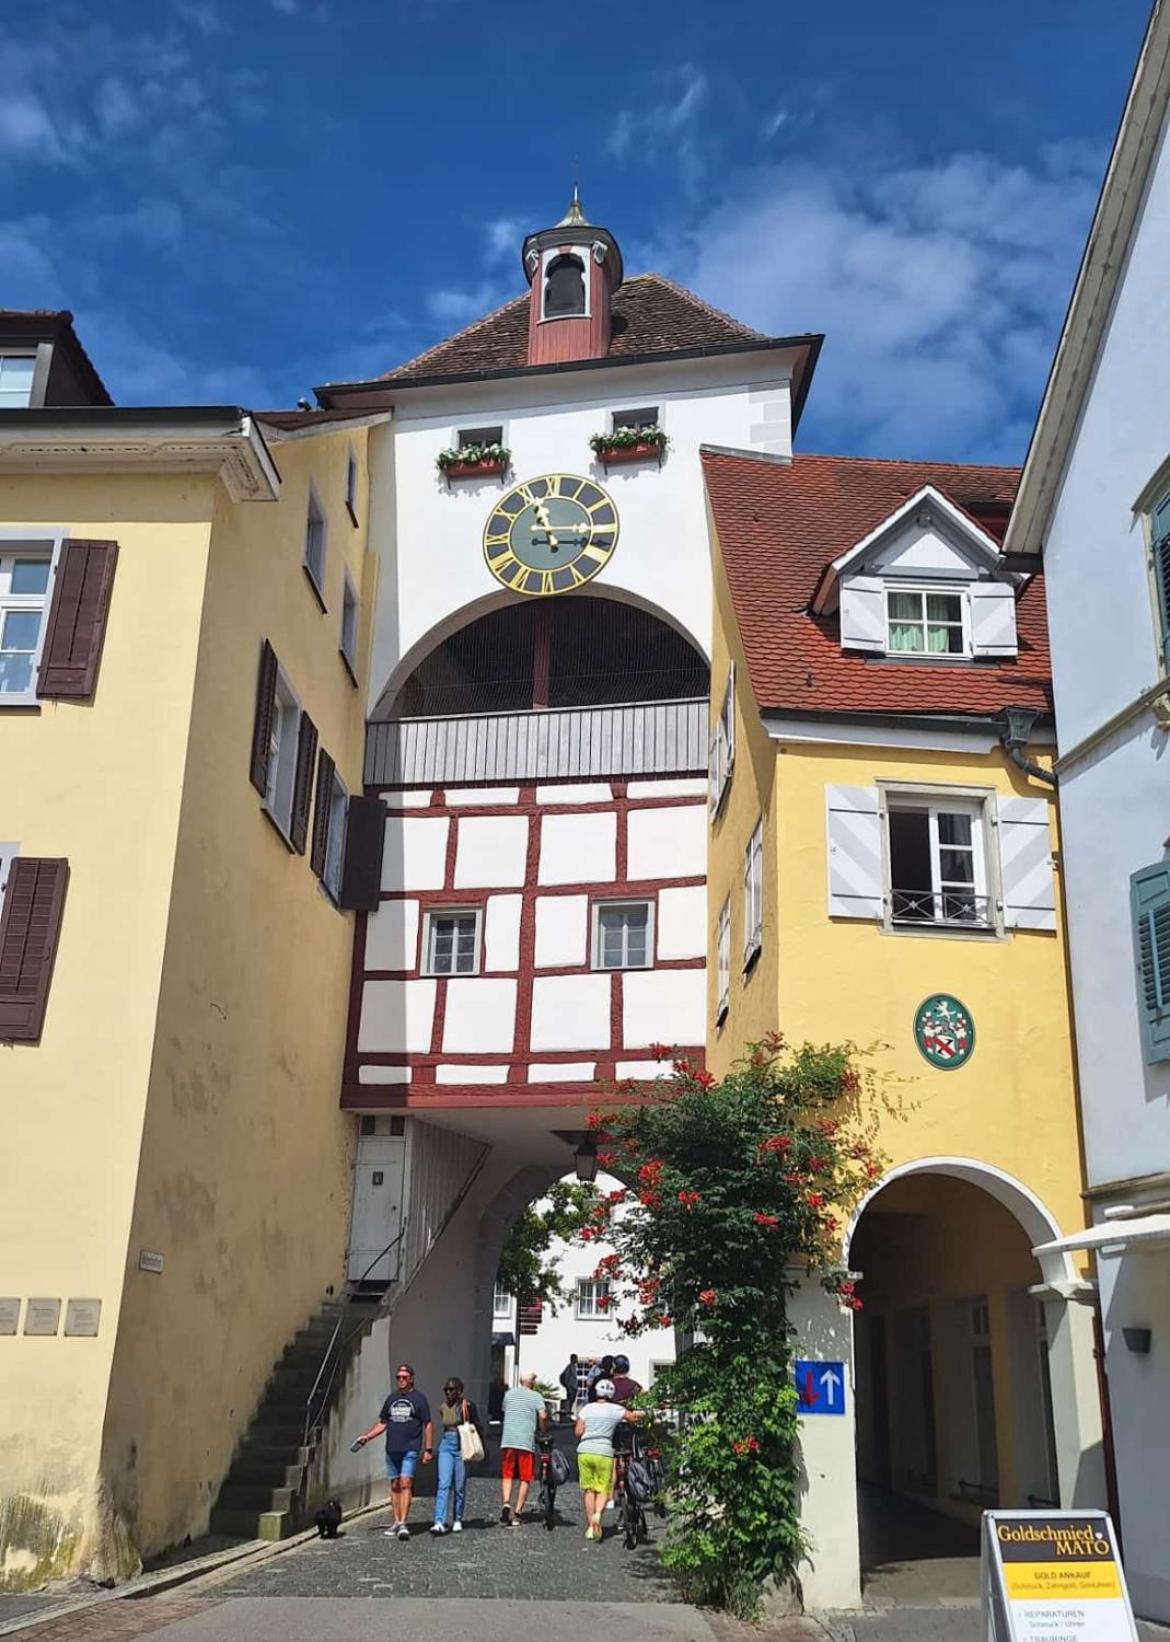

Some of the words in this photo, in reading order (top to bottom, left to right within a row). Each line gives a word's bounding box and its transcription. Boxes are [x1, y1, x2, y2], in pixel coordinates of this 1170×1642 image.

[545, 477, 561, 497] XII
[493, 505, 518, 523] X
[998, 1524, 1094, 1542] Goldschmied
[1056, 1540, 1110, 1556] MATO
[1034, 1571, 1057, 1580] GOLD
[1059, 1571, 1091, 1580] ANKAUF
[1024, 1609, 1085, 1619] REPARATUREN
